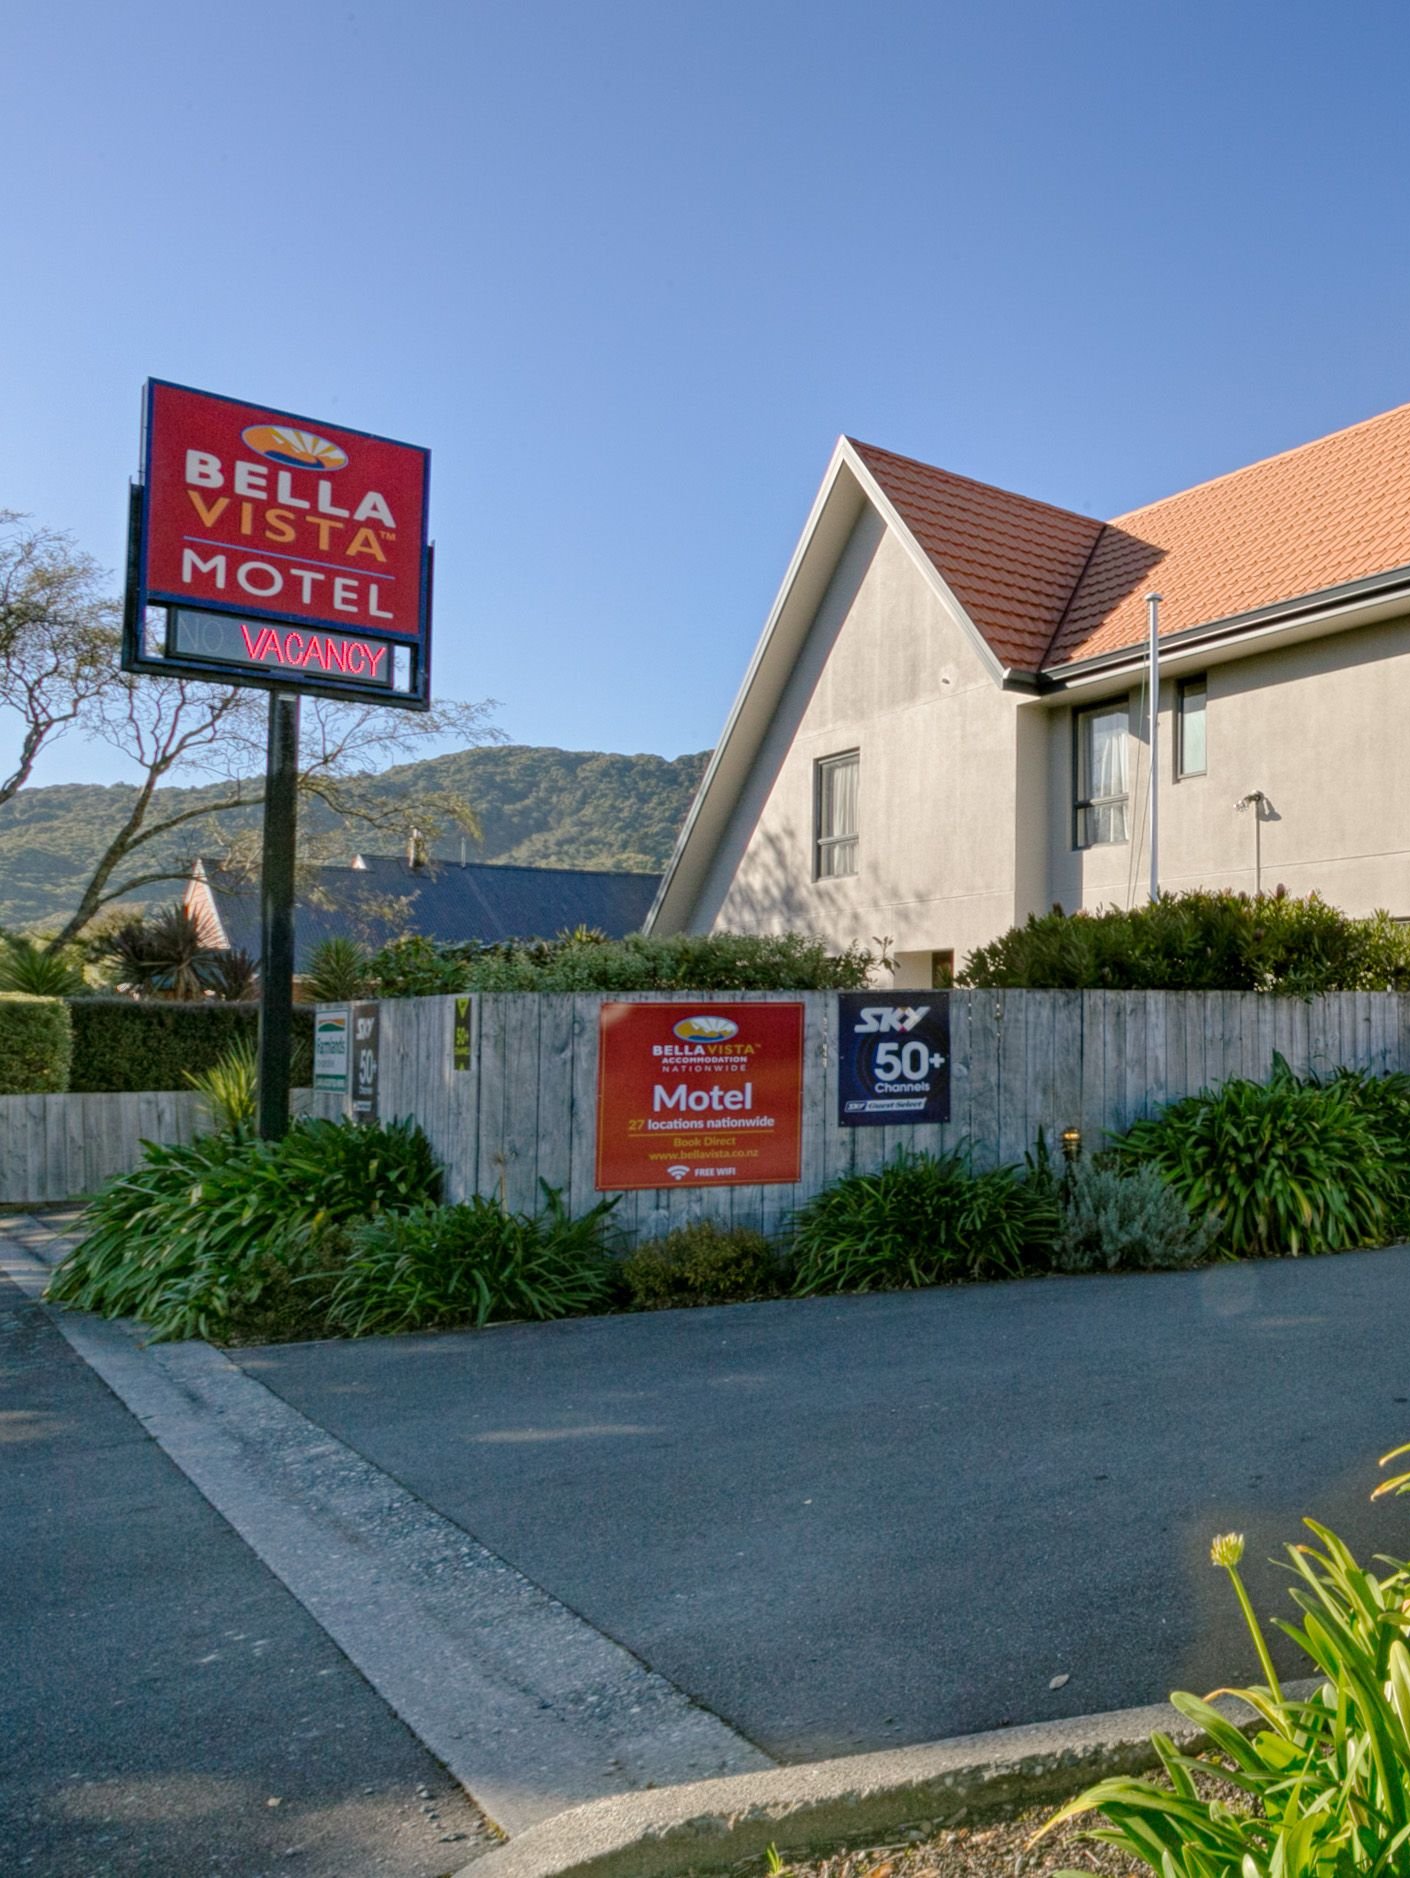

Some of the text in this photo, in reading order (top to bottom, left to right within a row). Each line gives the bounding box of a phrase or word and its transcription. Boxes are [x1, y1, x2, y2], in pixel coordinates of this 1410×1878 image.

[184, 448, 397, 529] BELLA
[181, 547, 394, 619] MOTEL
[178, 616, 387, 678] NO VACANCY
[854, 1005, 931, 1034] SKY
[652, 1044, 706, 1056] BELLA
[661, 1056, 748, 1064] ACCOMMODATION
[873, 1040, 945, 1081] 50+
[661, 1064, 747, 1073] NATIONWIDE
[874, 1082, 930, 1093] Channels
[653, 1082, 753, 1112] Motel
[868, 1102, 894, 1110] Guest
[895, 1101, 923, 1109] Select
[628, 1115, 775, 1131] 27 locations nationwide
[673, 1136, 737, 1147] Book Direct
[648, 1149, 760, 1161] www.bellavista.co.nz
[694, 1167, 737, 1177] FREE WIFI
